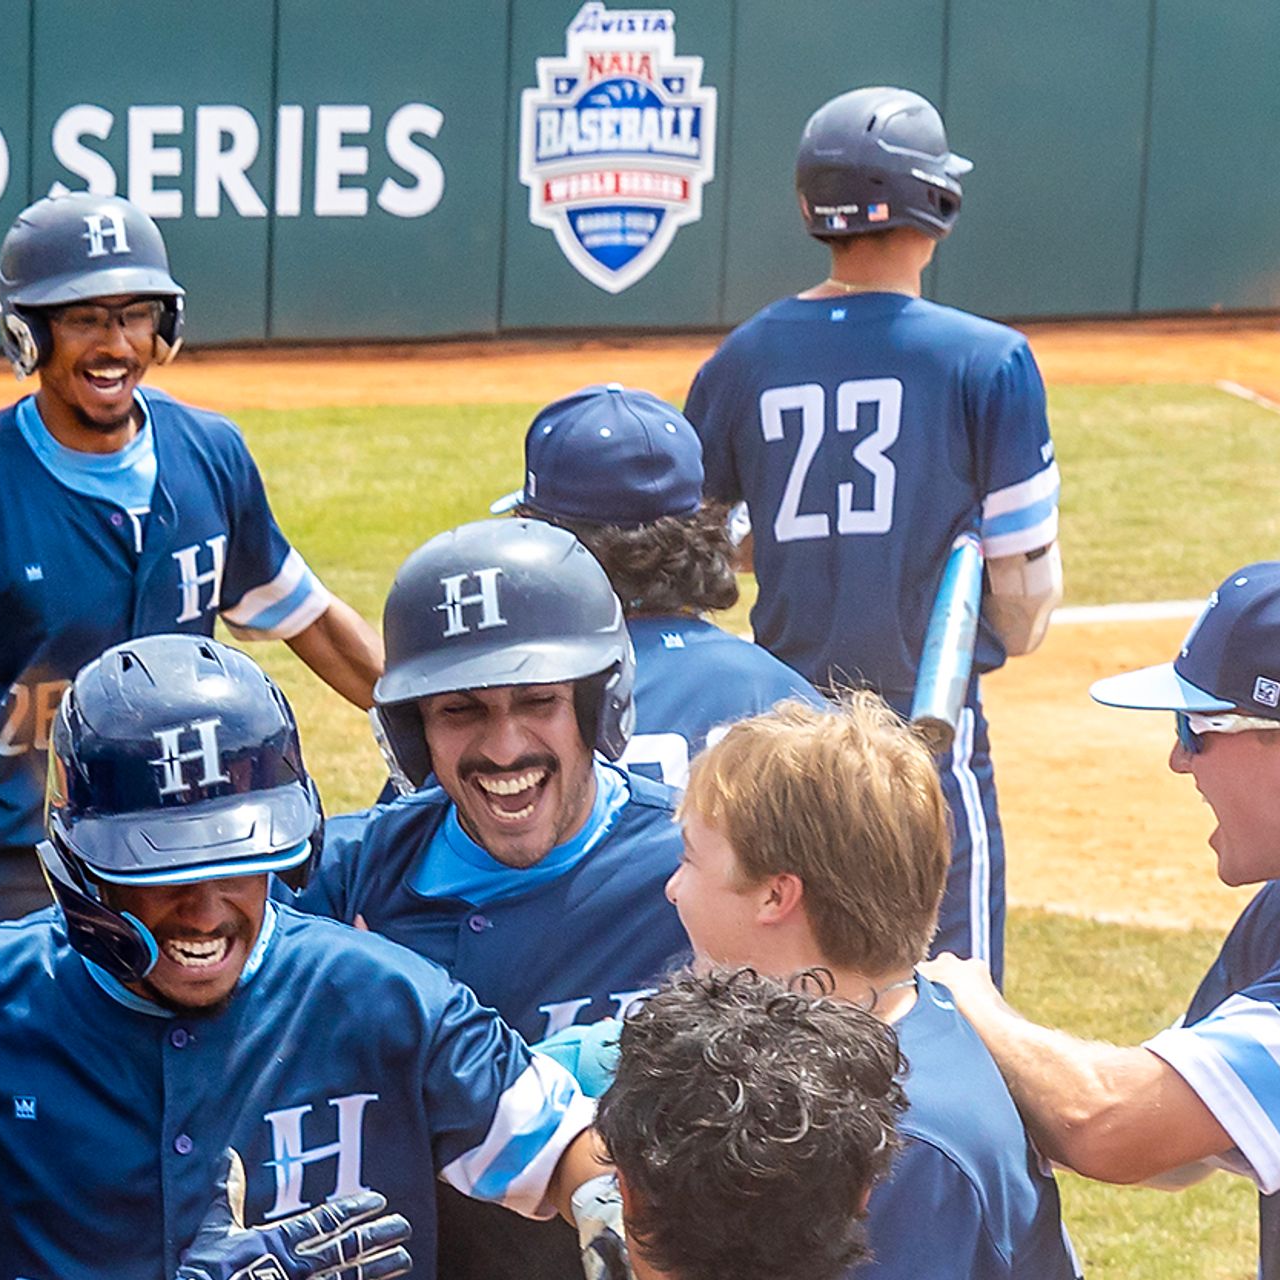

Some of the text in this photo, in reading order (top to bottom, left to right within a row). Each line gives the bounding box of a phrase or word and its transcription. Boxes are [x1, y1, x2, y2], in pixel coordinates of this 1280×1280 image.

[587, 52, 654, 81] NAIA
[52, 103, 445, 218] SERIES
[537, 107, 700, 158] BASEBALL
[83, 214, 131, 257] H
[760, 378, 903, 542] 23
[171, 534, 227, 623] H
[433, 567, 508, 637] H
[147, 717, 231, 795] H
[263, 1093, 378, 1219] H
